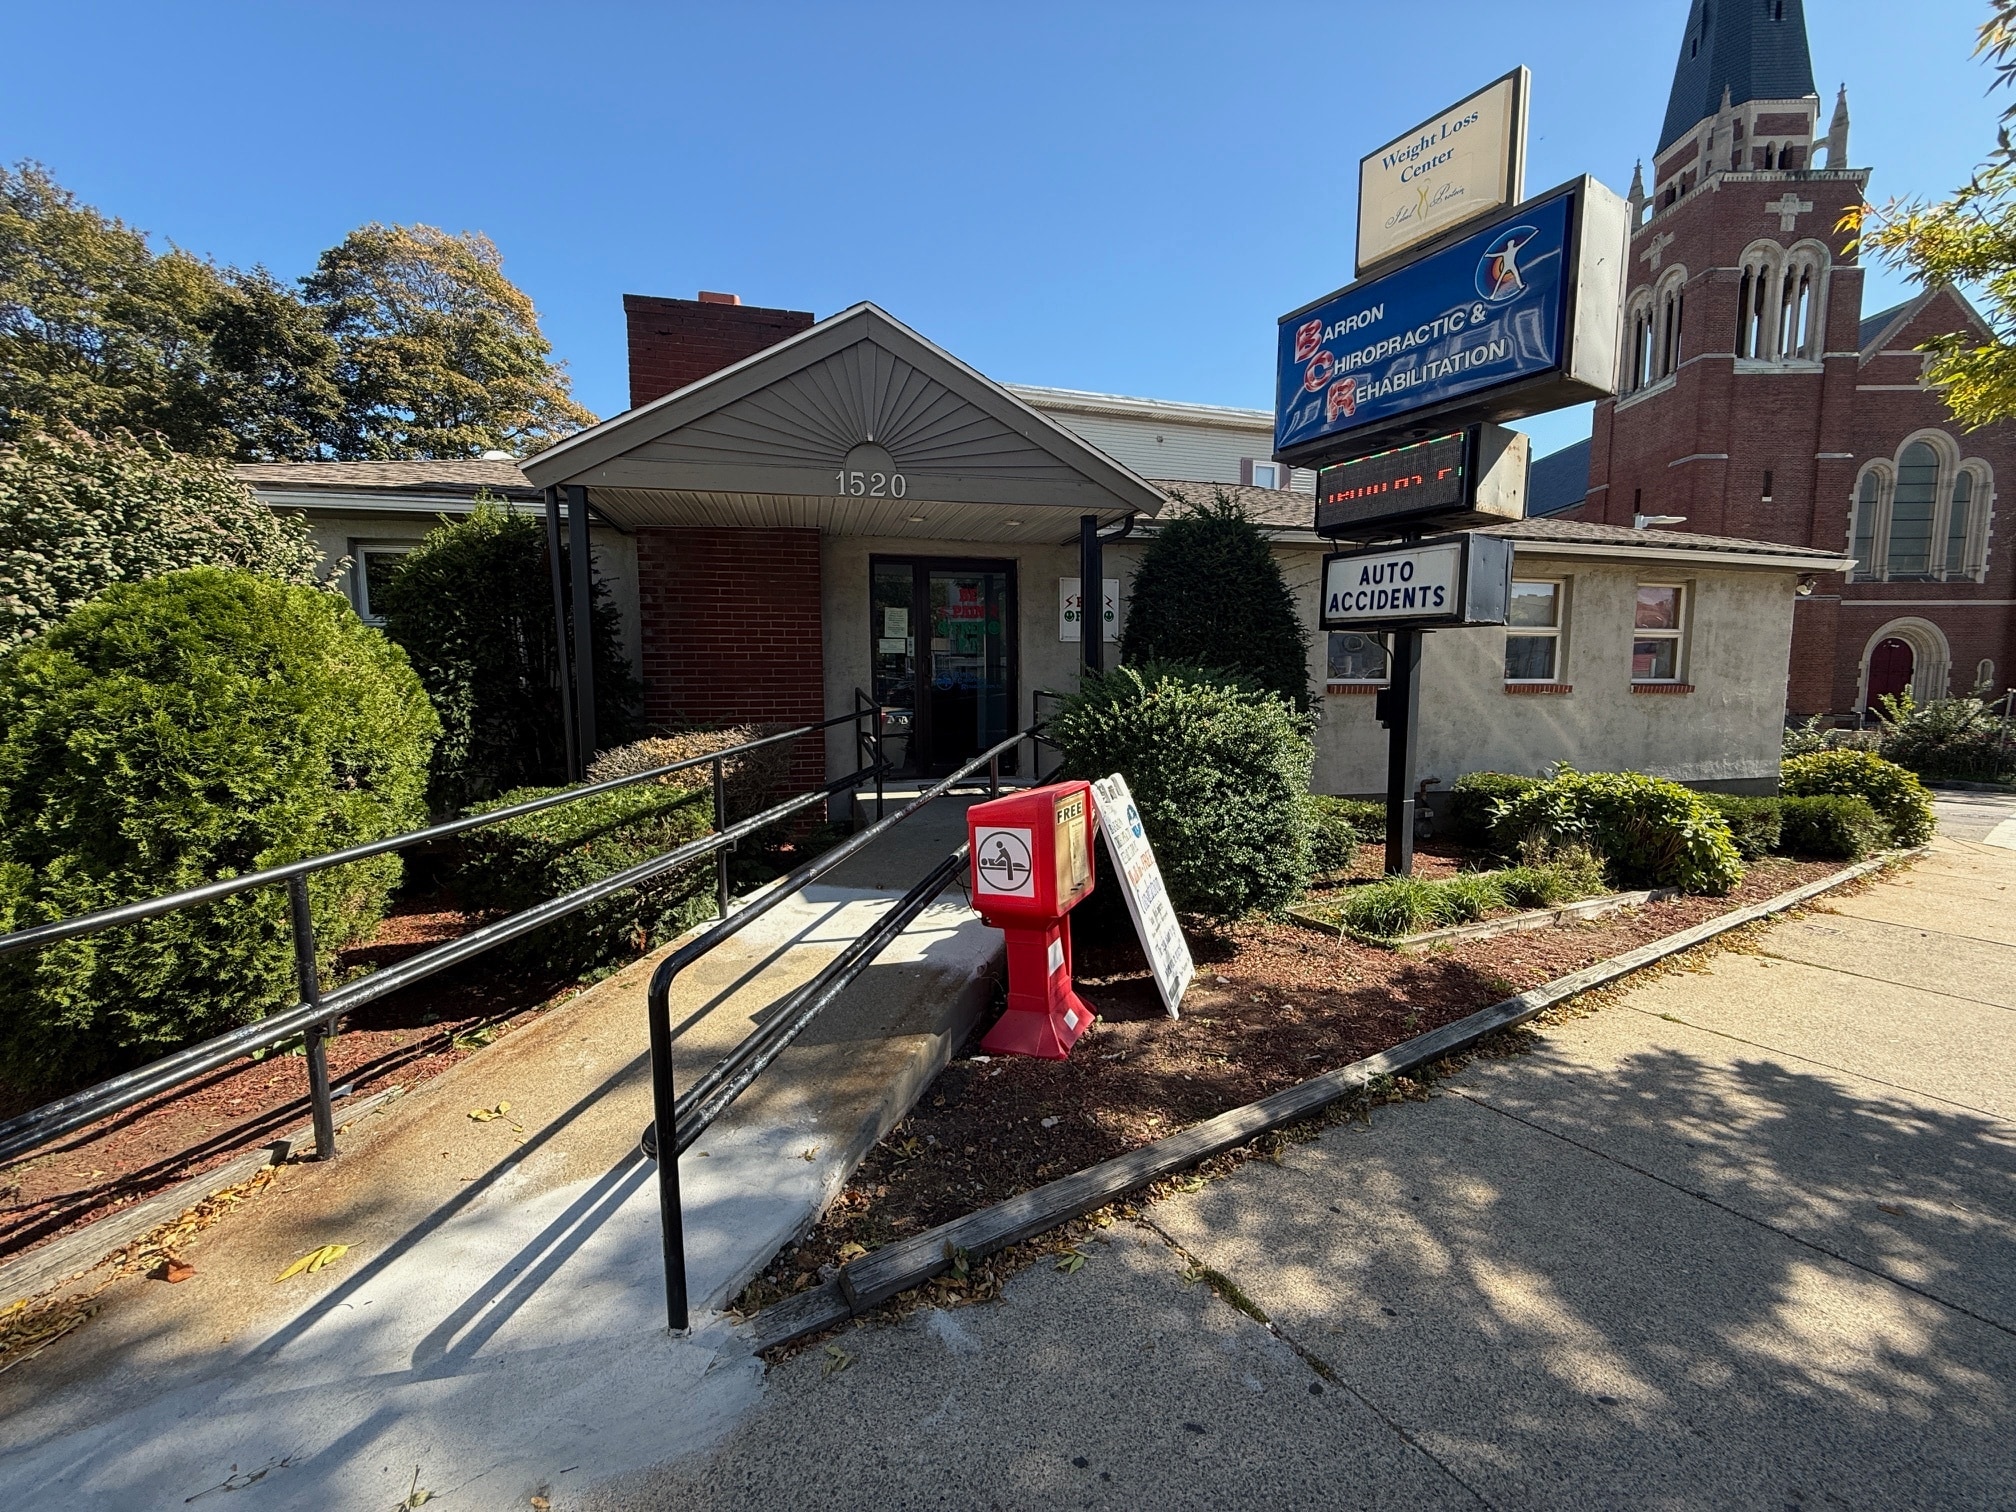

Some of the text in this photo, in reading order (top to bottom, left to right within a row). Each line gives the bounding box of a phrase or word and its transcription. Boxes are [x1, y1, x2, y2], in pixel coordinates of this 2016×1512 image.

[1382, 110, 1479, 172] Weight Loss
[1400, 147, 1455, 183] Center
[1295, 303, 1385, 364] BARRON
[1304, 302, 1487, 393] CHIROPRACTIC &
[1327, 338, 1507, 423] REHABILITATION
[835, 469, 907, 499] 1520
[1359, 560, 1414, 586] AUTO
[1329, 585, 1446, 613] ACCIDENTS
[1057, 802, 1082, 824] FREE
